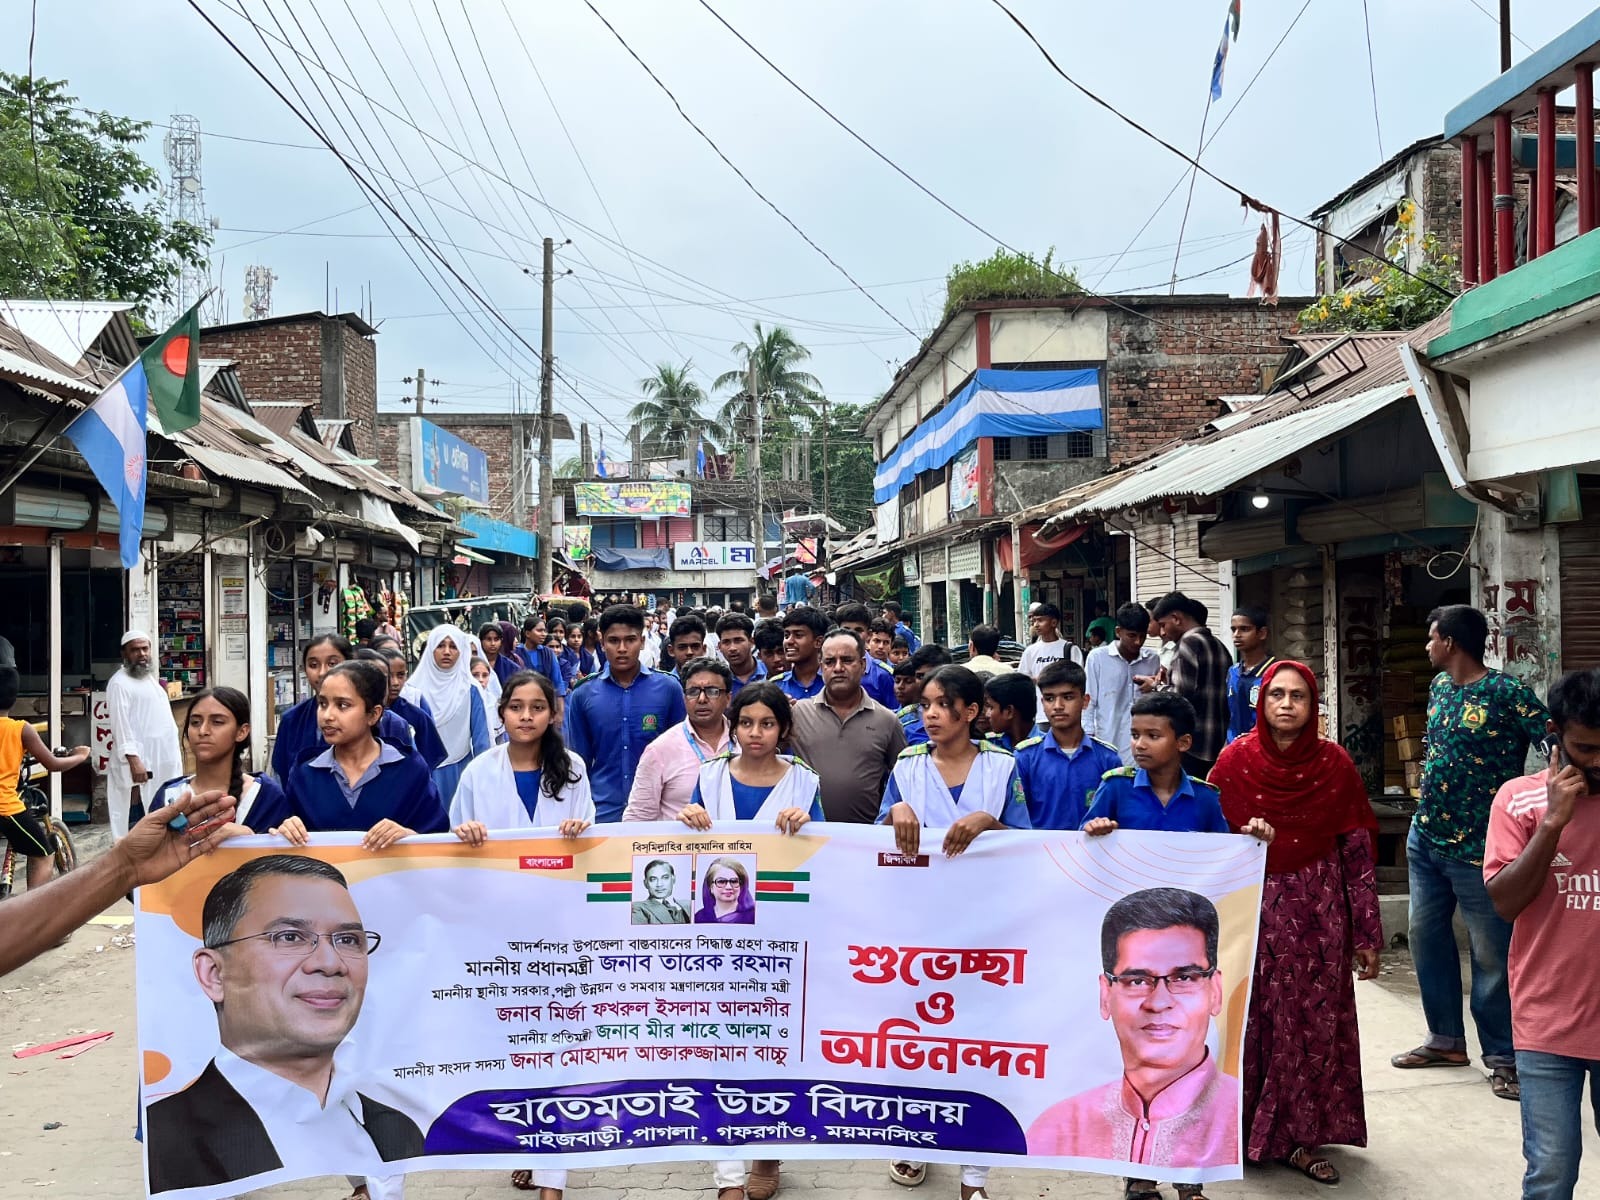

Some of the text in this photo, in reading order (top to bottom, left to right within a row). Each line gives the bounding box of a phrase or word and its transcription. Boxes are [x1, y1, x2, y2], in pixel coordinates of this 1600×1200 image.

[681, 558, 719, 566] MARCEL
[1036, 655, 1063, 664] Activ
[727, 839, 753, 852] রাহিম
[525, 857, 564, 867] বাংলাদেশ
[1566, 894, 1591, 910] FLY
[507, 935, 799, 954] আদর্শনগর উপজেলা বাস্তবায়নের সিদ্ধান্ত গ্রহণ করায়
[464, 953, 793, 977] মাননীয় প্রধানমন্ত্রী জনাব তারেক রহমান
[848, 945, 1028, 987] শুভেচ্ছা
[431, 984, 473, 1001] মাননীয়
[475, 983, 509, 1000] স্থানীয়
[580, 981, 613, 996] উন্নয়ন
[617, 982, 626, 992] ও
[630, 981, 666, 993] সমবায়
[729, 978, 767, 993] মাননীয়
[495, 997, 791, 1023] জনাব মির্জা ফখরুল ইসলাম আলমগীর
[915, 991, 955, 1025] ও
[507, 1029, 548, 1045] মাননীয়
[595, 1023, 641, 1040] জনাব
[646, 1018, 675, 1039] মীর
[681, 1022, 721, 1040] শাহে
[725, 1022, 772, 1040] আলম
[777, 1027, 789, 1039] ও
[820, 1018, 1049, 1079] অভিনন্দন
[393, 1044, 790, 1080] মাননীয় সংসদ সদস্য জনাব মোহাম্মদ আক্তারুজ্জামান বাচ্চু
[488, 1082, 972, 1128] হাতেমতাই উচ্চ বিদ্যালয়
[823, 1124, 939, 1145] ময়মনসিংহ
